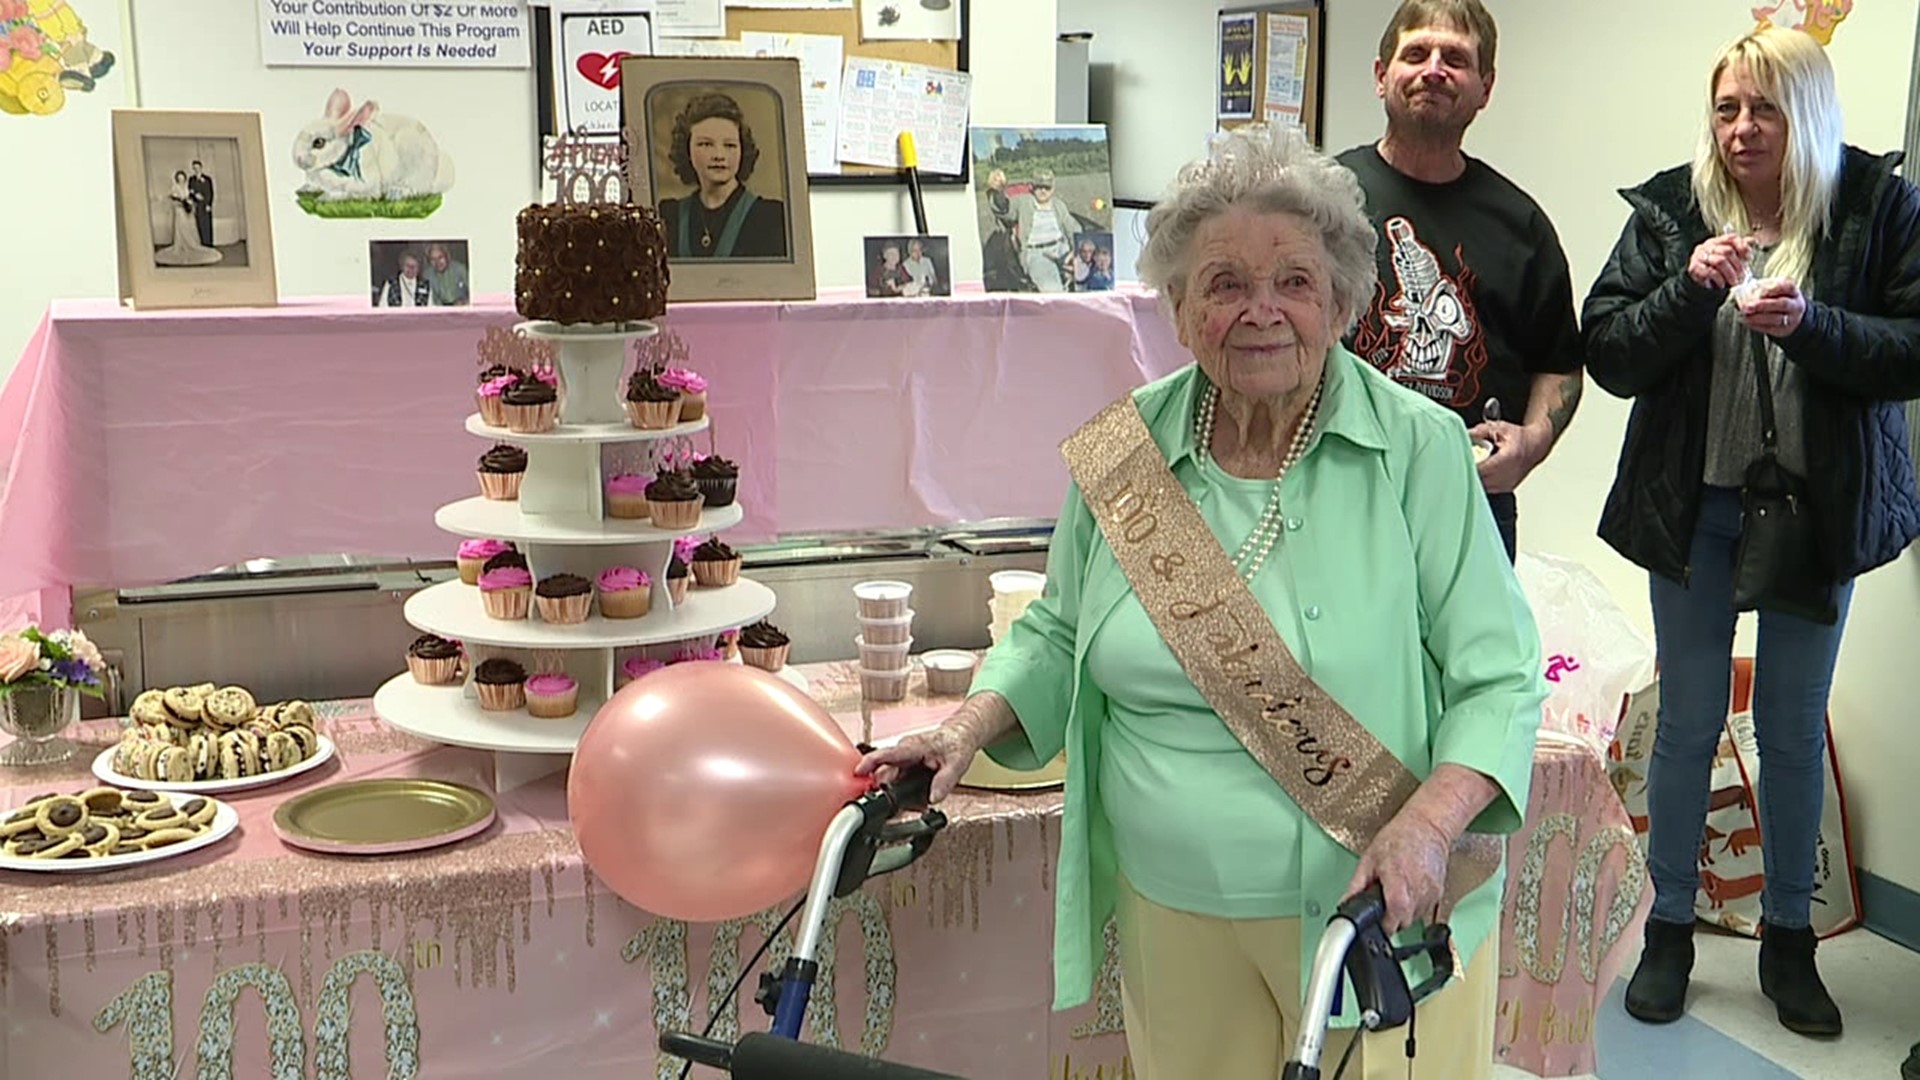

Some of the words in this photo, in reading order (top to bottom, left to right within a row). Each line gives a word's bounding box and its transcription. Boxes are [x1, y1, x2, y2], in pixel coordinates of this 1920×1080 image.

[270, 0, 308, 14] Your
[312, 0, 406, 16] Contribution
[411, 3, 430, 16] Of
[457, 5, 476, 17] Or
[480, 6, 518, 17] More
[271, 20, 300, 35] Will
[305, 21, 341, 38] Help
[346, 21, 415, 37] Continue
[420, 23, 451, 37] This
[456, 24, 519, 41] Program
[587, 19, 624, 35] AED
[303, 42, 342, 56] Your
[347, 42, 412, 60] Support
[417, 44, 430, 57] Is
[436, 44, 497, 58] Needed
[585, 101, 618, 112] LOCAT
[1104, 483, 1158, 545] 100
[1151, 551, 1186, 582] &
[1168, 588, 1351, 787] Fabulous
[415, 937, 443, 969] th
[92, 950, 419, 1080] 100
